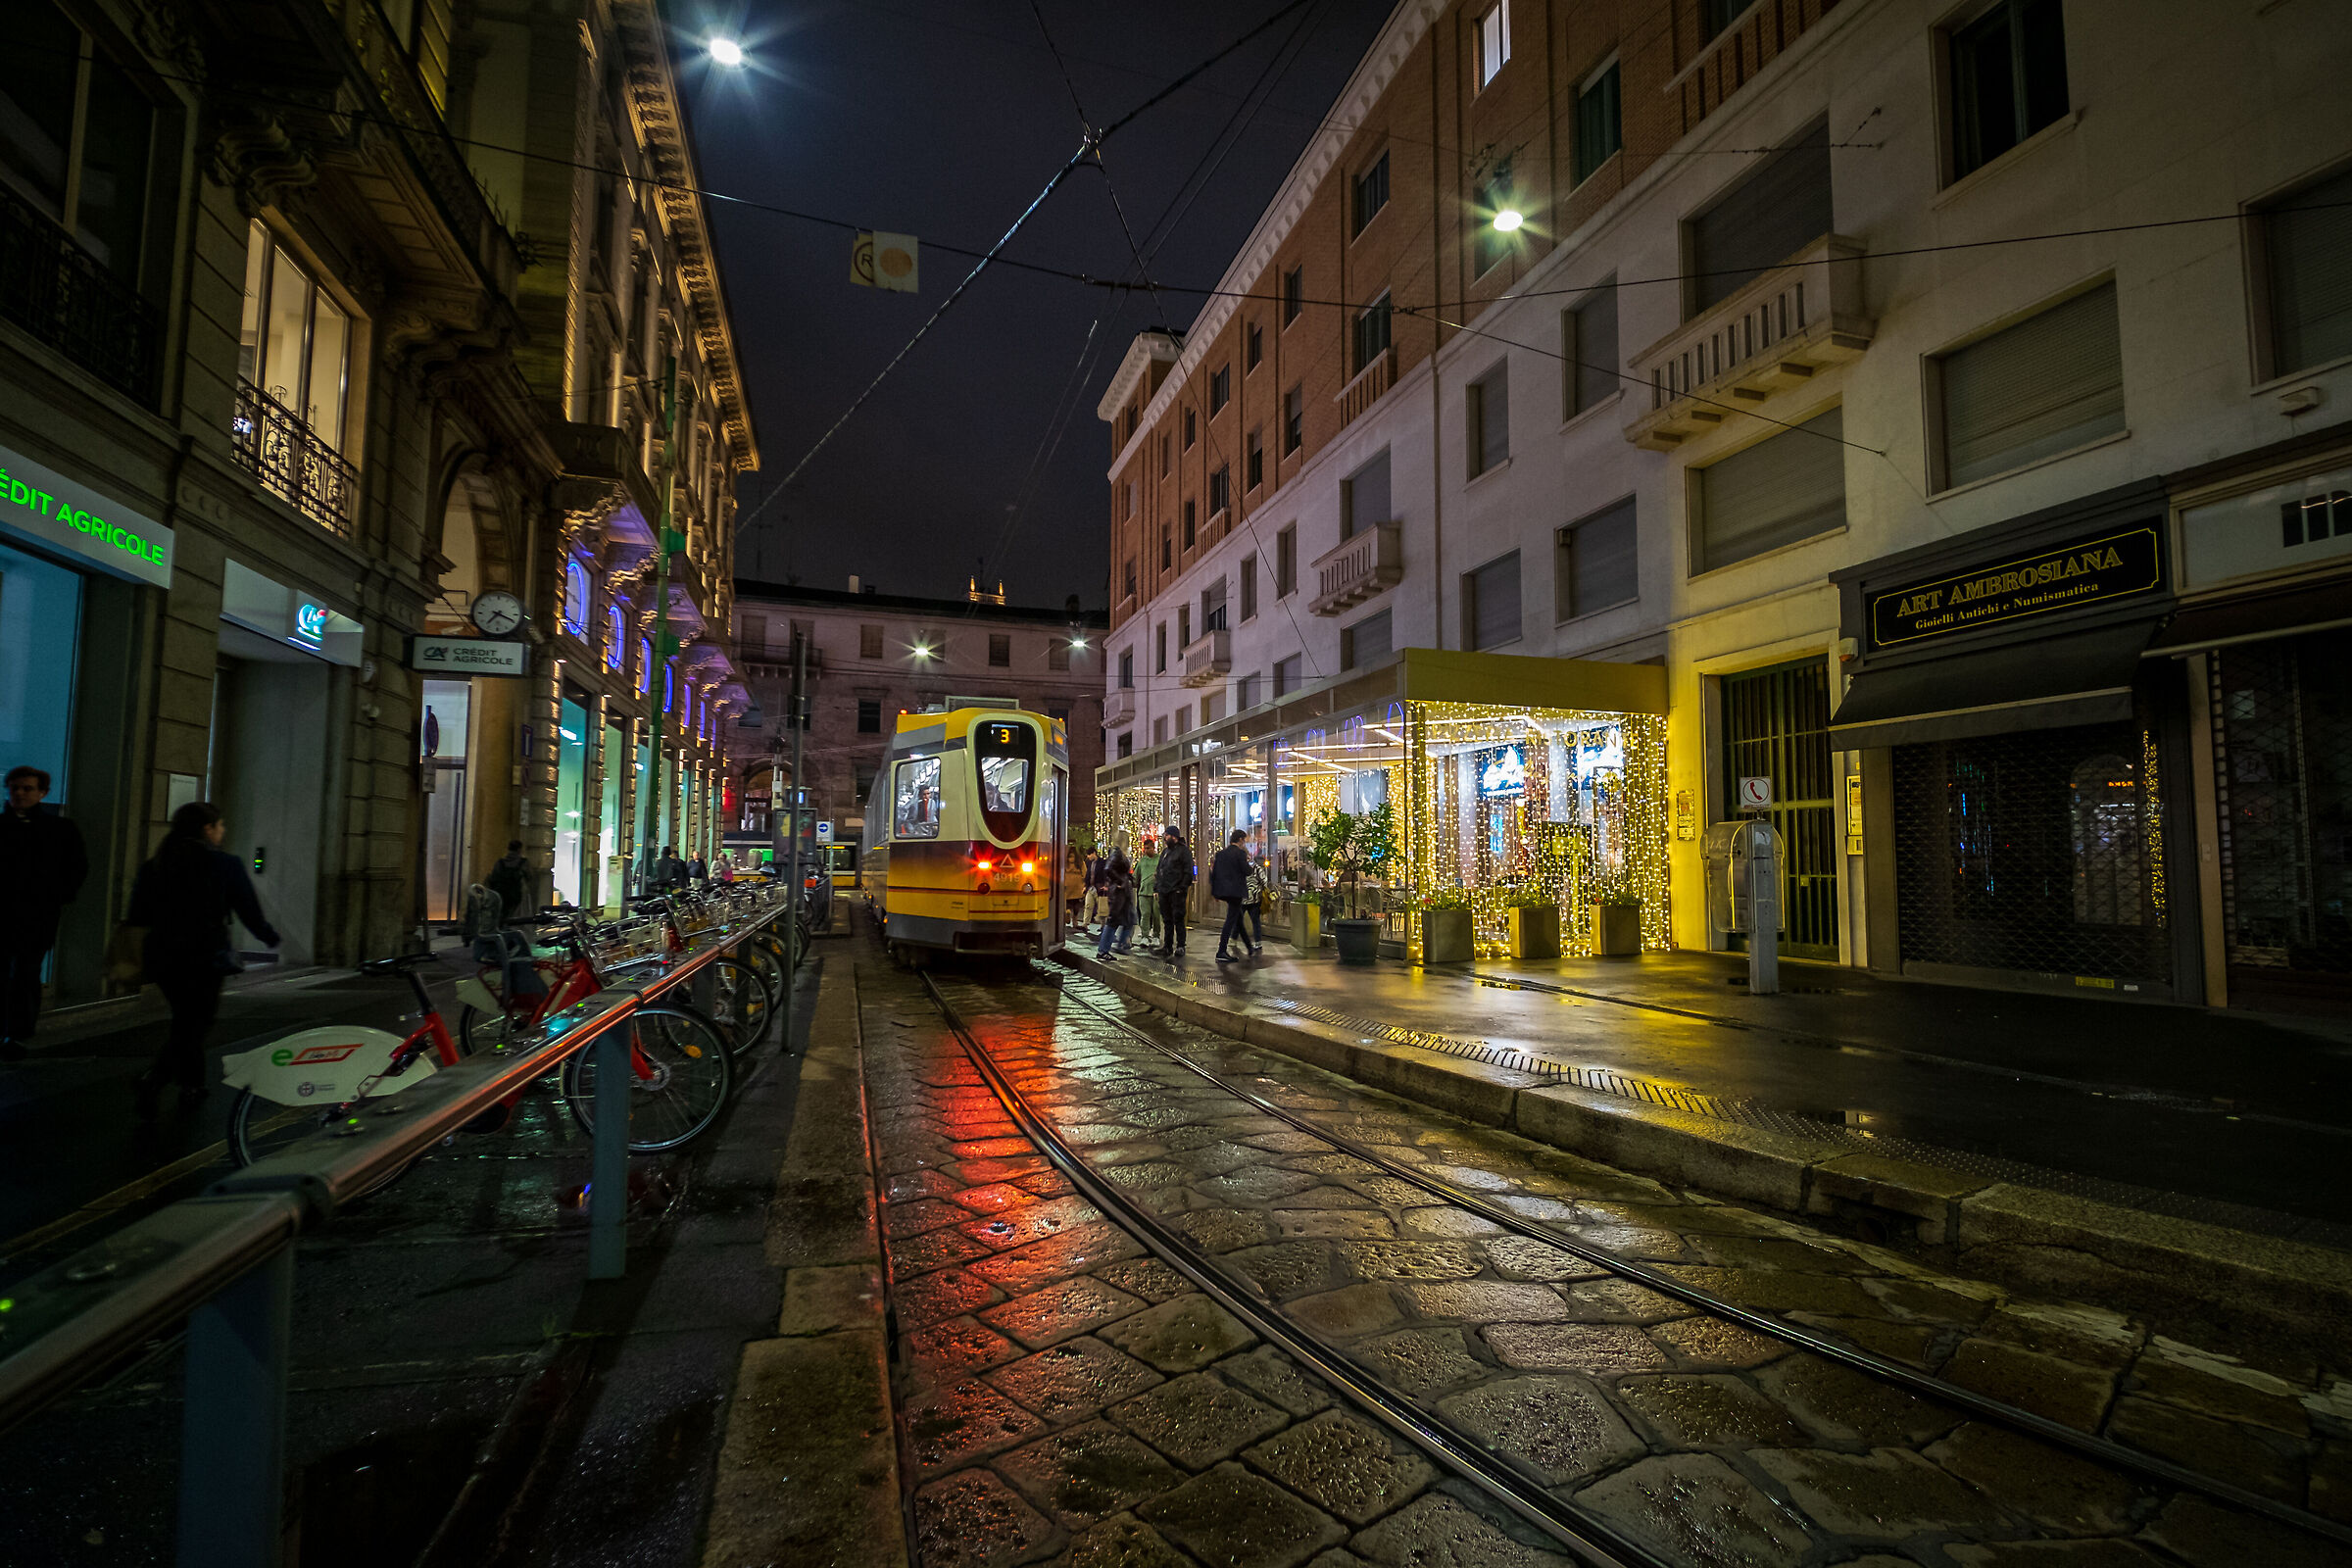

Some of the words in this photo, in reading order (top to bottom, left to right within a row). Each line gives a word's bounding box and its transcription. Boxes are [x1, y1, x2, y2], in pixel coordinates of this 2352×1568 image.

[55, 502, 165, 566] AGRICOLE
[1896, 589, 1943, 618] ART
[1948, 545, 2124, 607] AMBROSIANA
[1915, 612, 1955, 631] Gioielli
[1957, 602, 2000, 622] Antichi
[2002, 602, 2010, 612] e
[2013, 582, 2099, 610] Numismatica
[453, 656, 514, 665] AGRICOLE
[1001, 728, 1009, 743] 3
